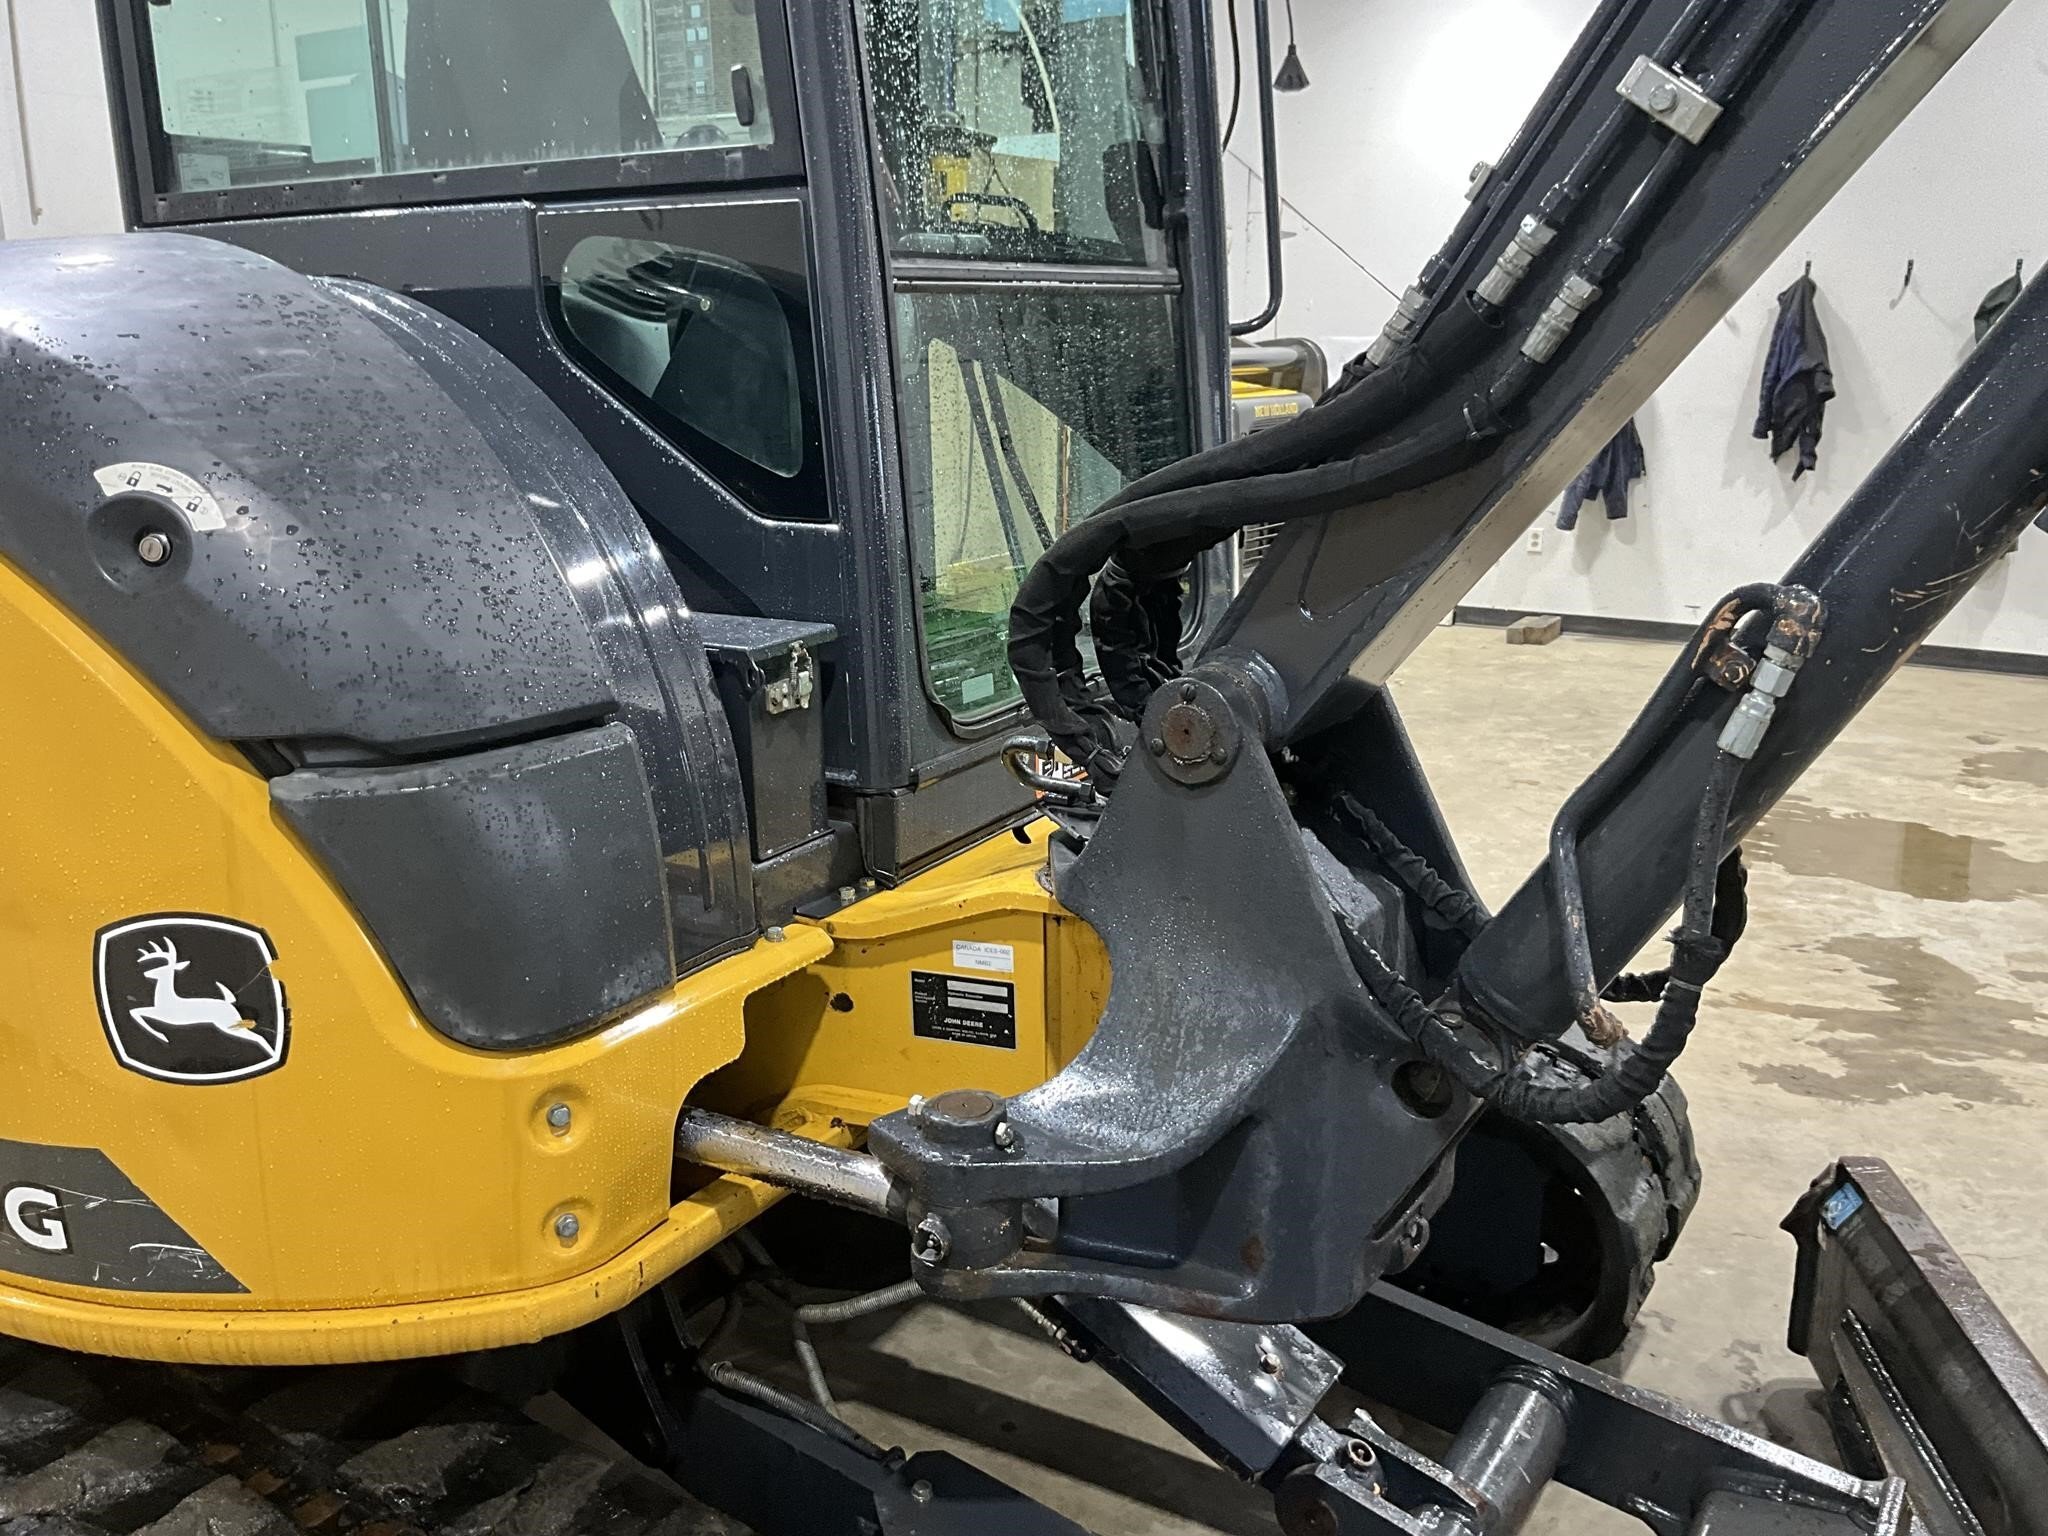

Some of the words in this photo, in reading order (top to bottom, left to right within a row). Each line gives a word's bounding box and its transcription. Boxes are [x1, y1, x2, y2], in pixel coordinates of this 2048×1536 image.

[955, 943, 982, 952] CANADA
[943, 1017, 961, 1025] JOHN
[962, 1019, 984, 1028] DEERE
[4, 1186, 68, 1250] G
